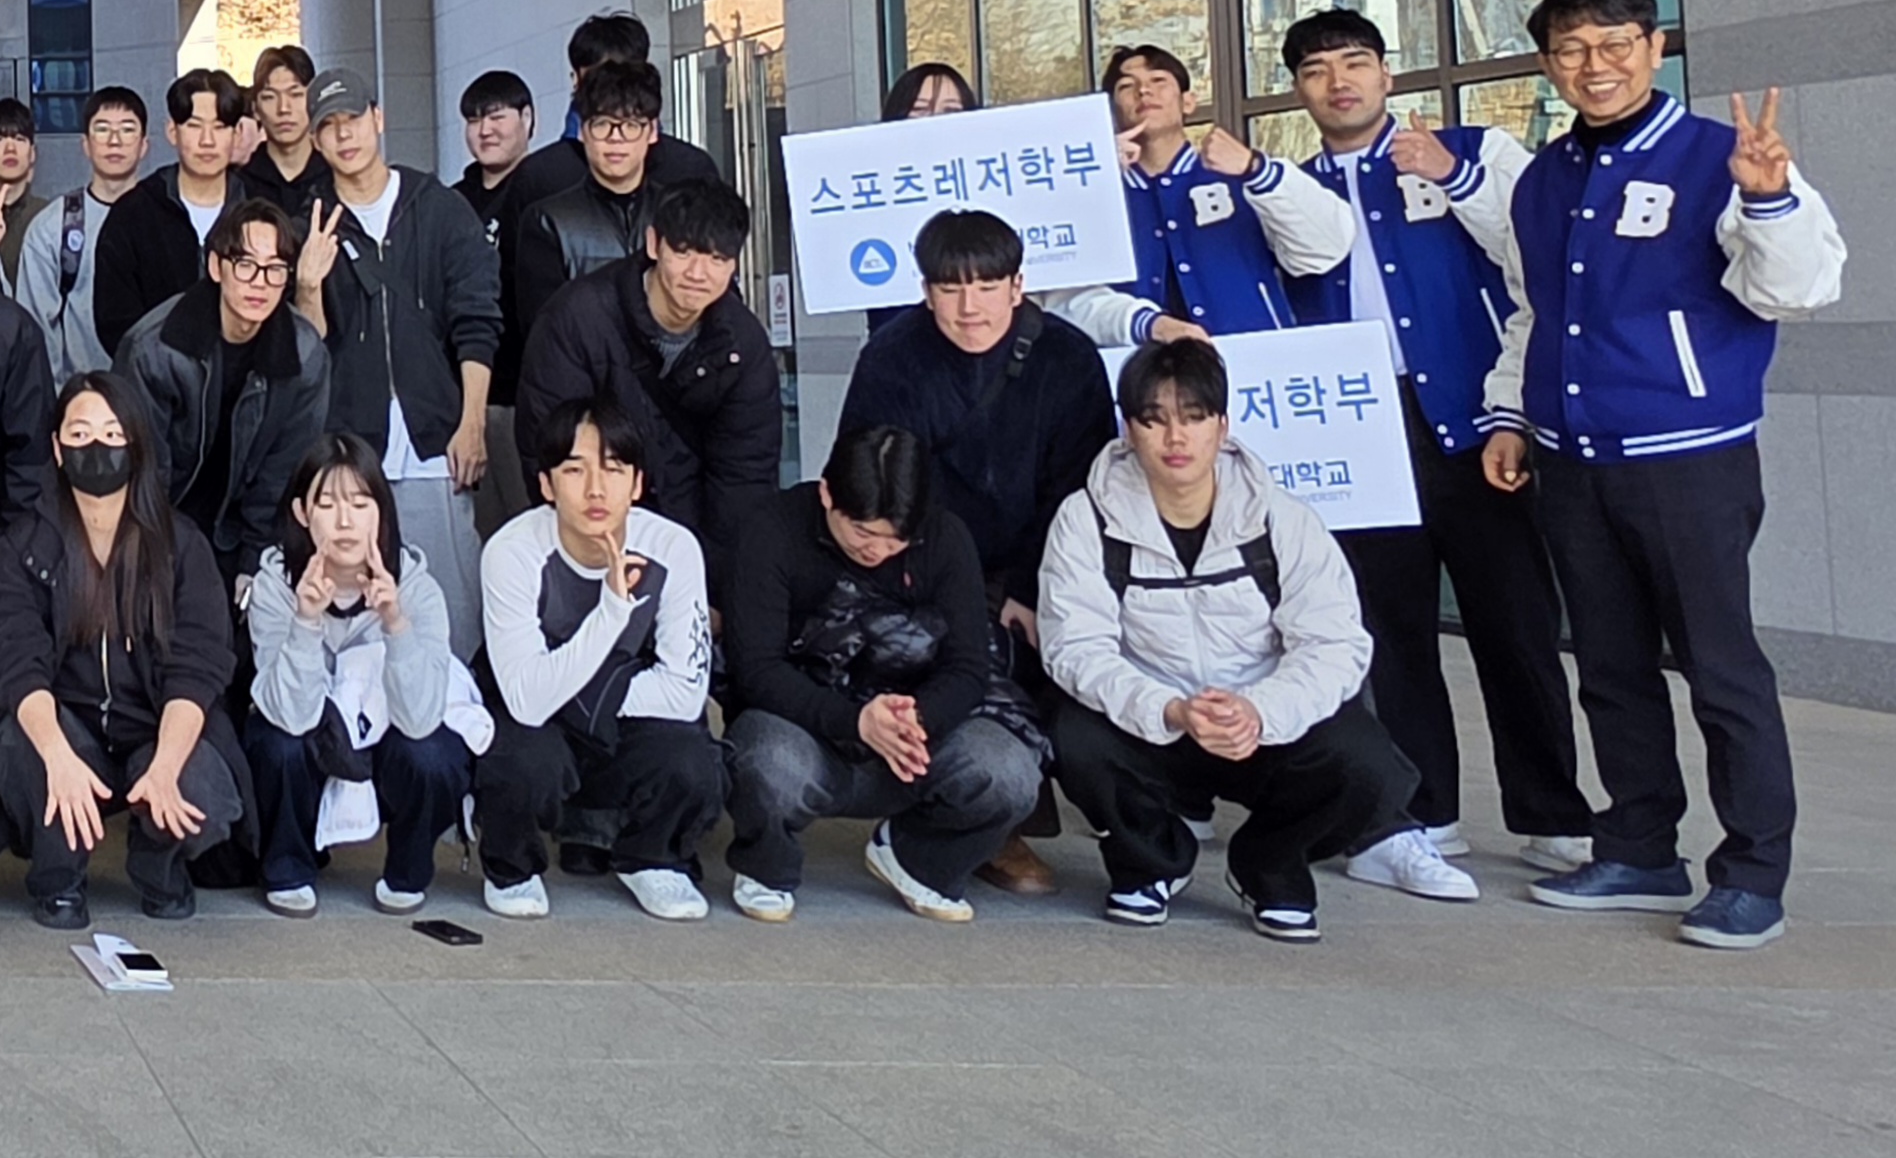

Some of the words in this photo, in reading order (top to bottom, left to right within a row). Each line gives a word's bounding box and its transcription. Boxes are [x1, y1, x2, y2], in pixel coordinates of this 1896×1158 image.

[809, 141, 1102, 215] 스포츠레저학부
[1189, 182, 1235, 226] B
[1397, 174, 1449, 222] B
[1615, 181, 1675, 237] B
